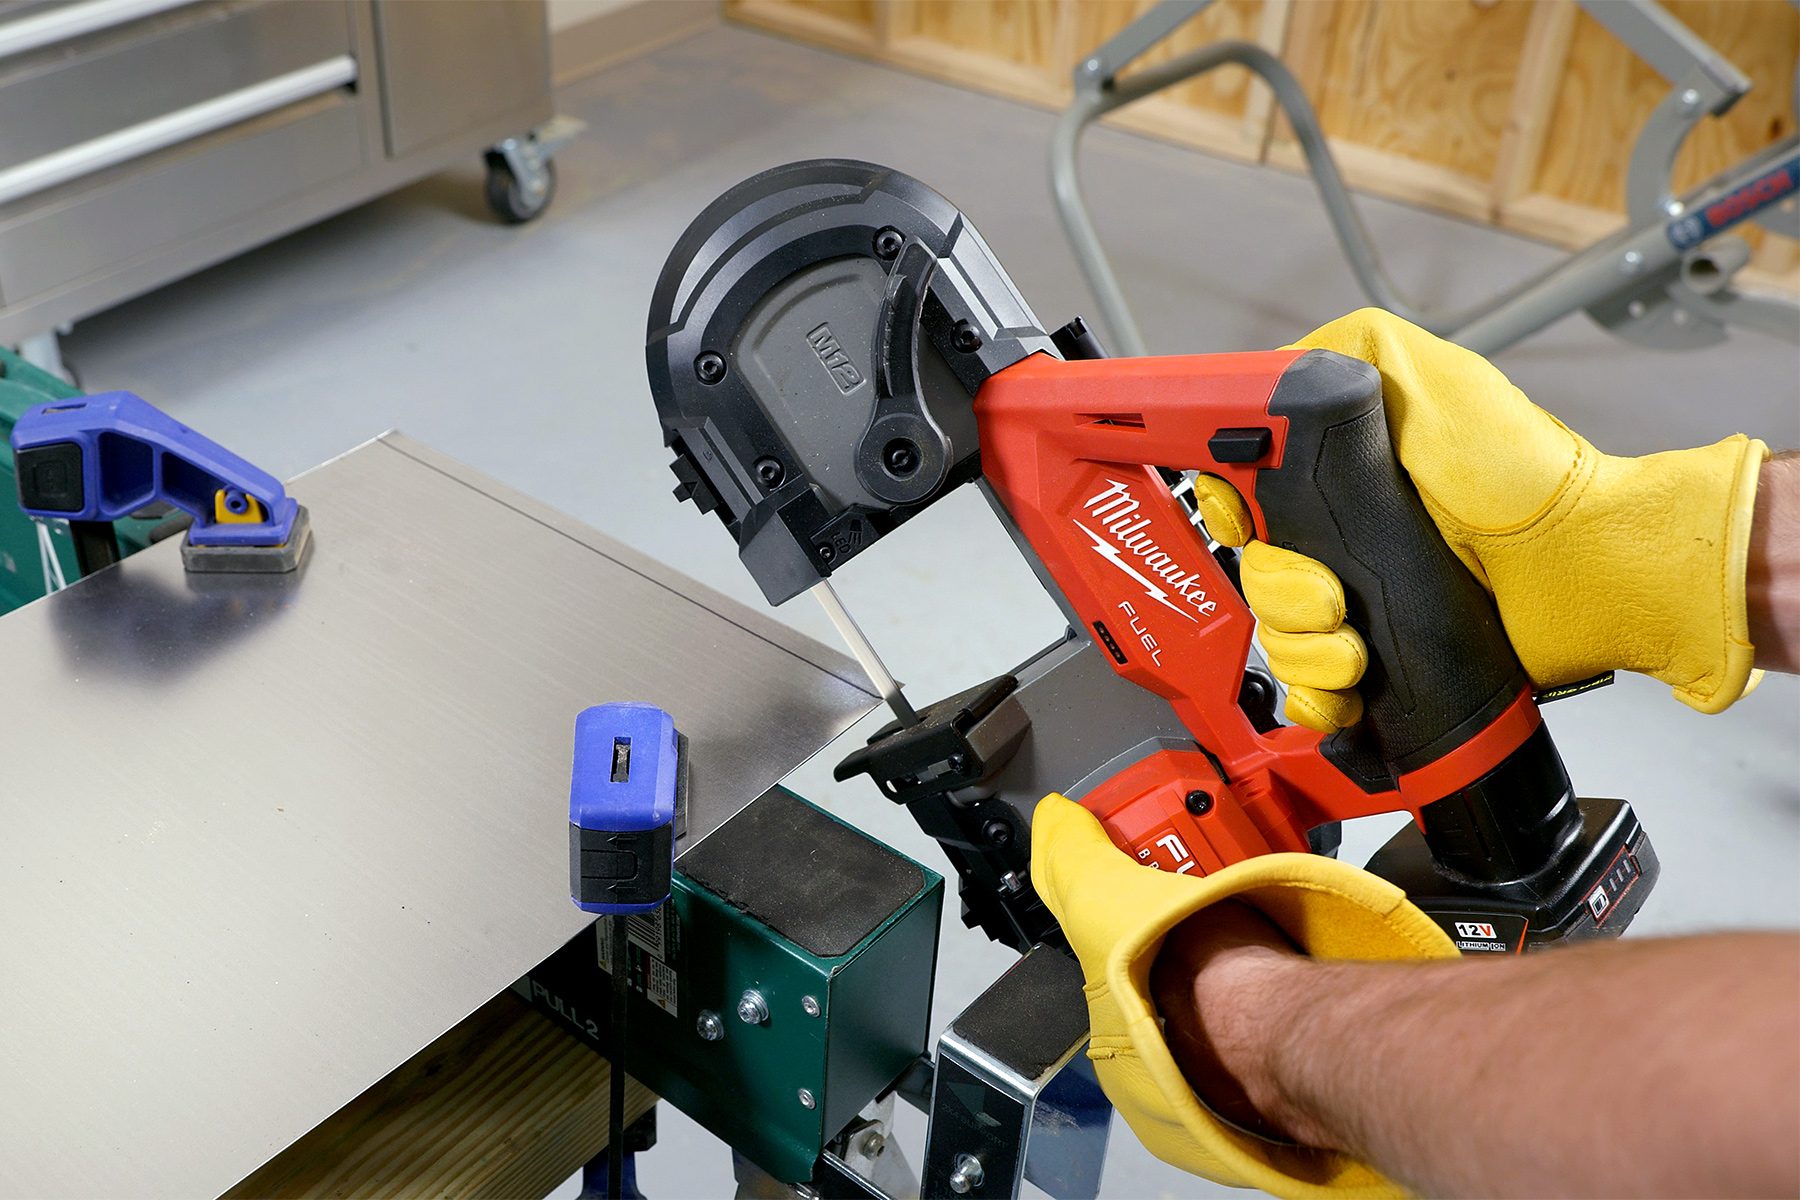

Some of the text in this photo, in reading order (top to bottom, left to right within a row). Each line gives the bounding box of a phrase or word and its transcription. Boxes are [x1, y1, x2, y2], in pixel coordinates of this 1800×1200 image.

[808, 325, 861, 389] M12
[831, 532, 852, 554] LED
[1083, 478, 1218, 617] Milwaukee
[1117, 600, 1162, 668] FUEL
[1456, 940, 1506, 952] LITHIUM ION
[1458, 923, 1492, 937] 12V
